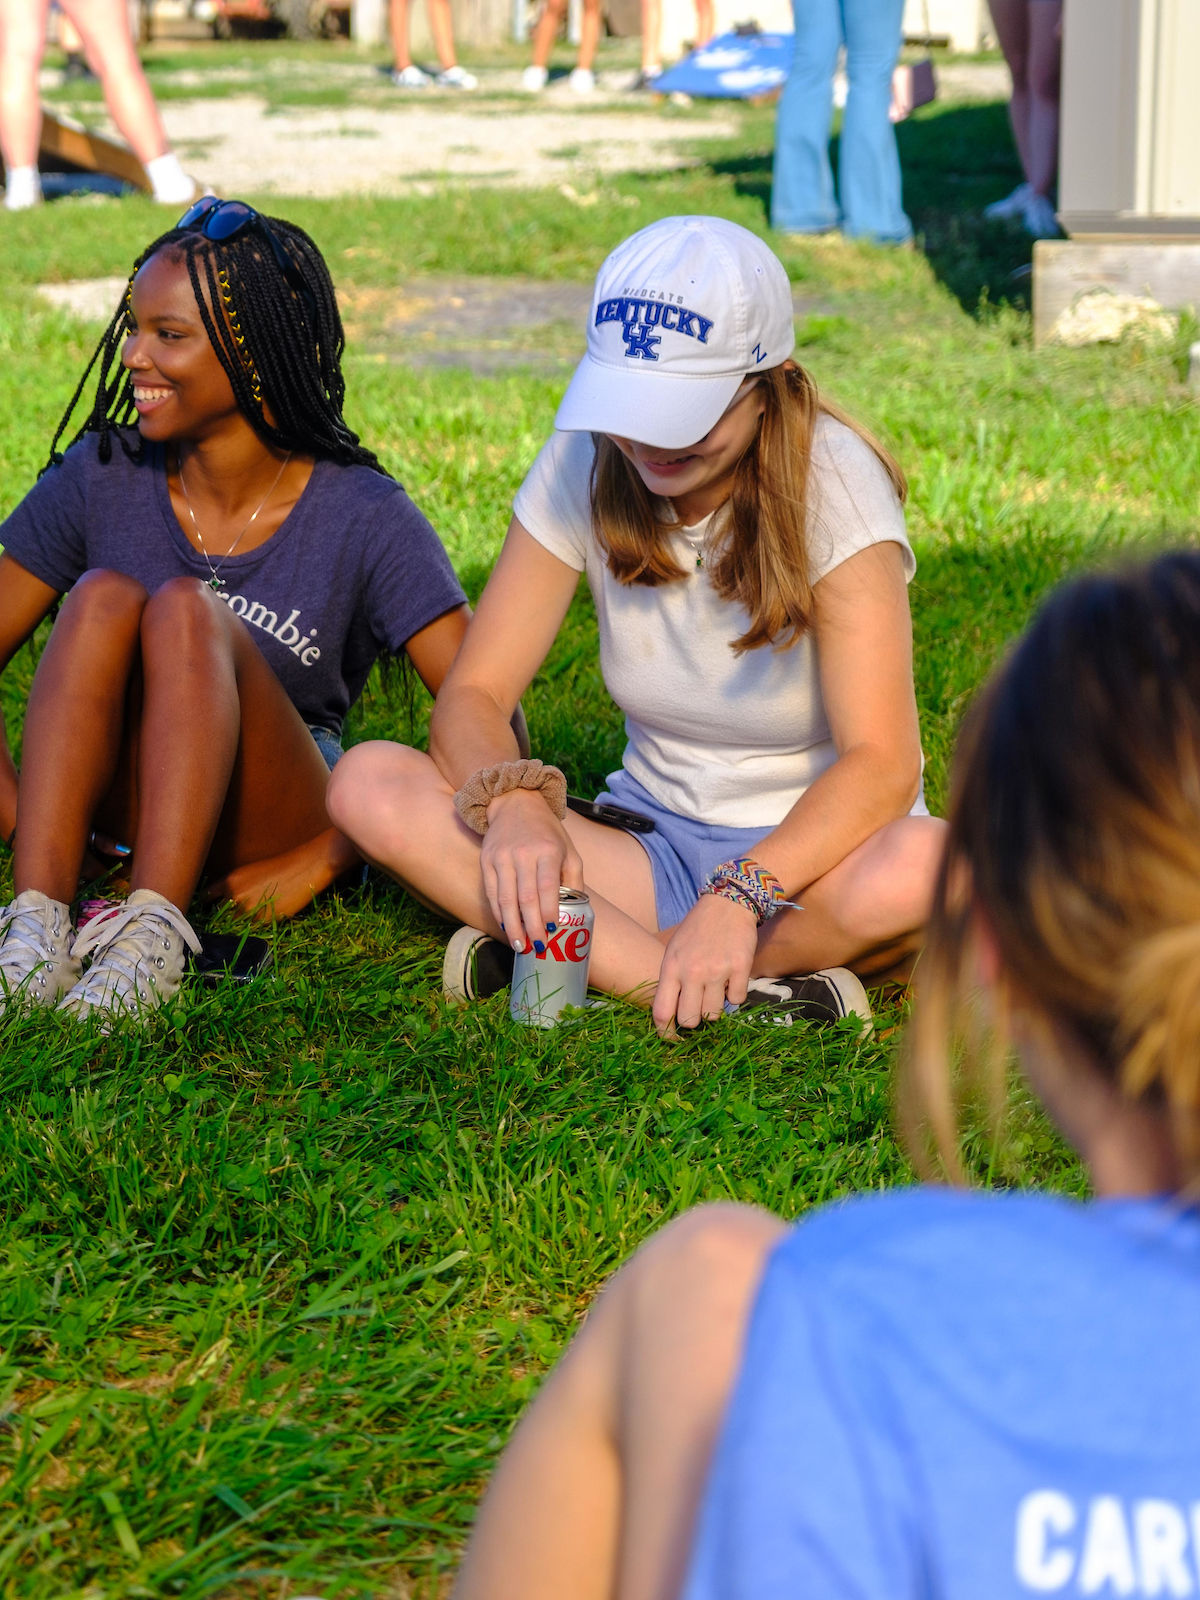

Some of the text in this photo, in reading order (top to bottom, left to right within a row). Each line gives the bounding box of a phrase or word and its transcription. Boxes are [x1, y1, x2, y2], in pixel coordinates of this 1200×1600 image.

[622, 287, 685, 305] WILDCATS
[595, 297, 714, 345] KENTUCKY
[622, 319, 662, 362] UK
[1015, 1489, 1200, 1599] CAR
